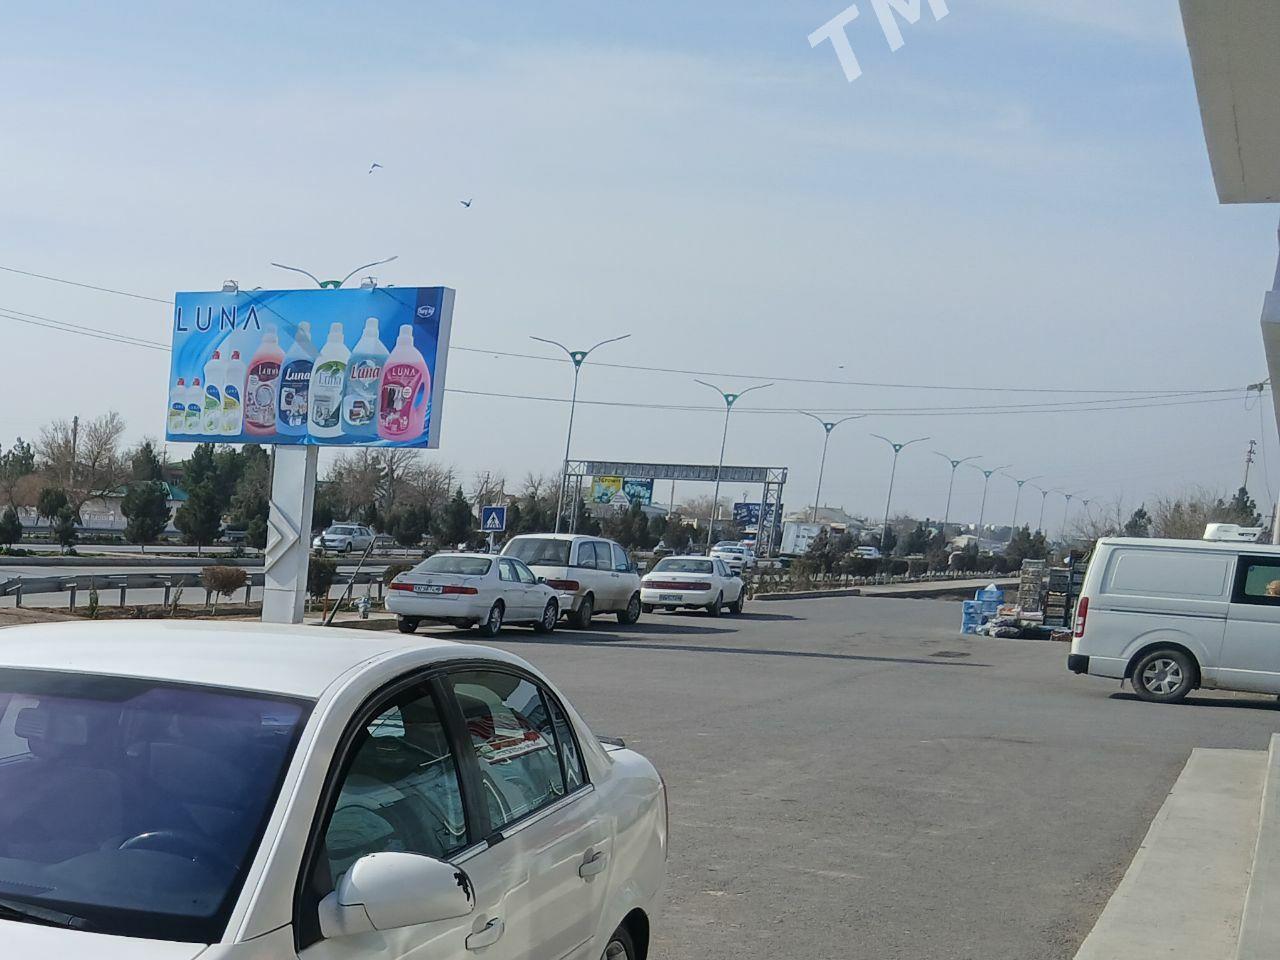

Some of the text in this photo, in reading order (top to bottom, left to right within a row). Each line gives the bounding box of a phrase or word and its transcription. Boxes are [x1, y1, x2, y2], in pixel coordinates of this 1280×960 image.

[176, 305, 261, 332] LUNA
[285, 368, 312, 381] Luna
[392, 367, 416, 376] LUNA
